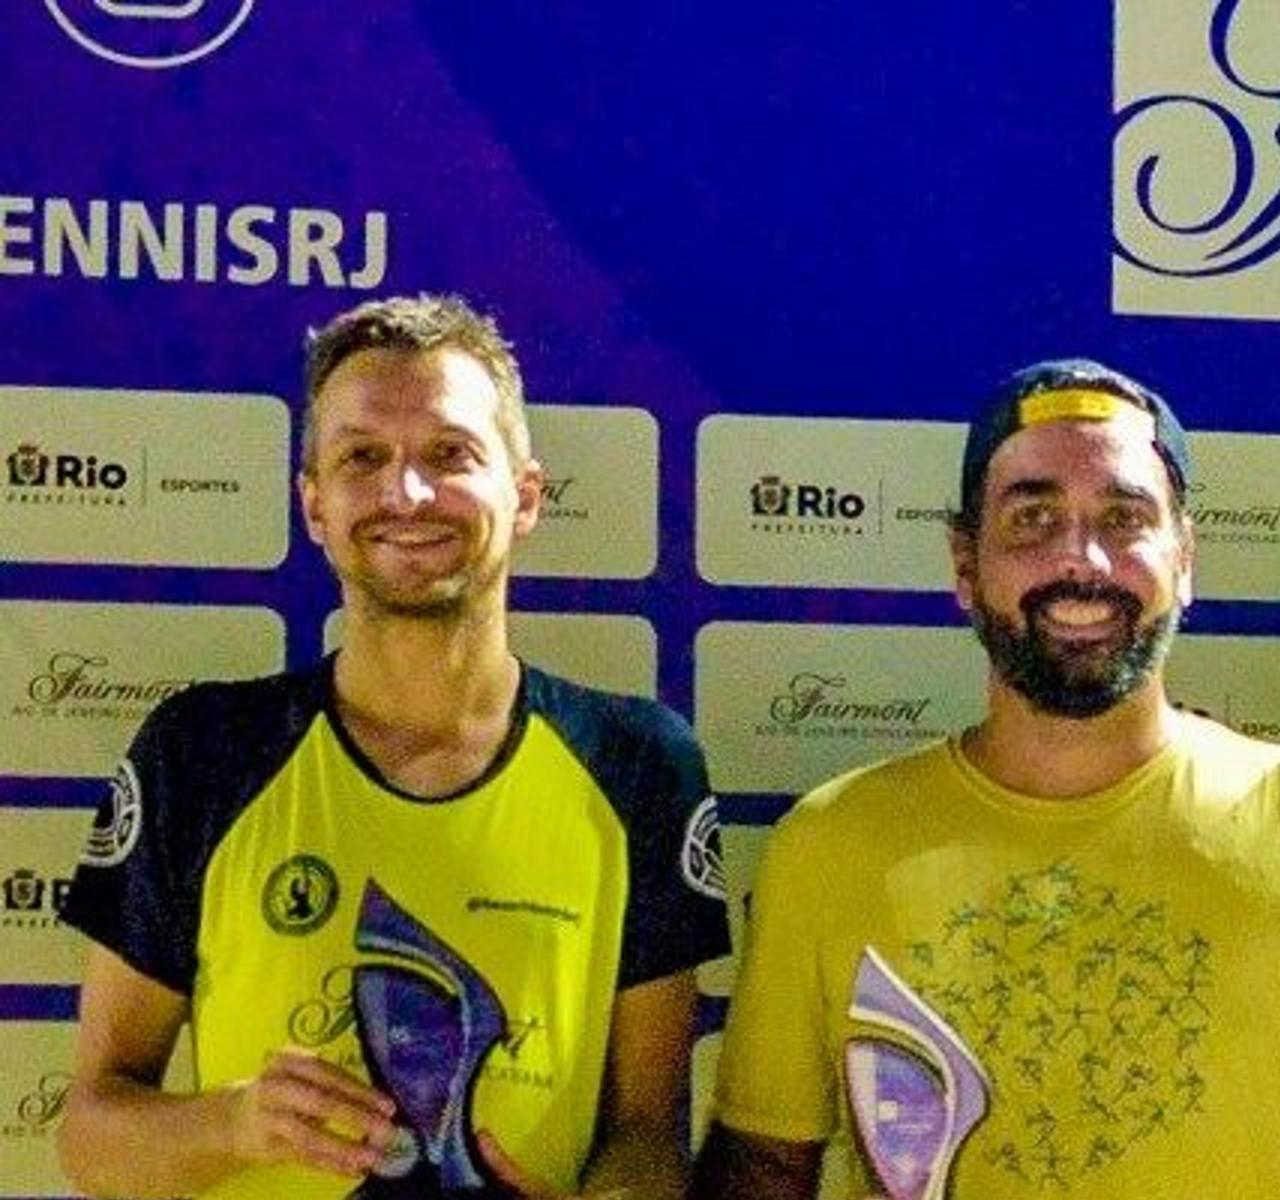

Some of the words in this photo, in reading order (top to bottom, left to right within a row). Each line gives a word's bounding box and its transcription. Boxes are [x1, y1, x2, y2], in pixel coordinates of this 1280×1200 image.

[56, 455, 128, 490] Rio
[797, 485, 865, 519] Rio
[769, 671, 930, 723] Fairmont
